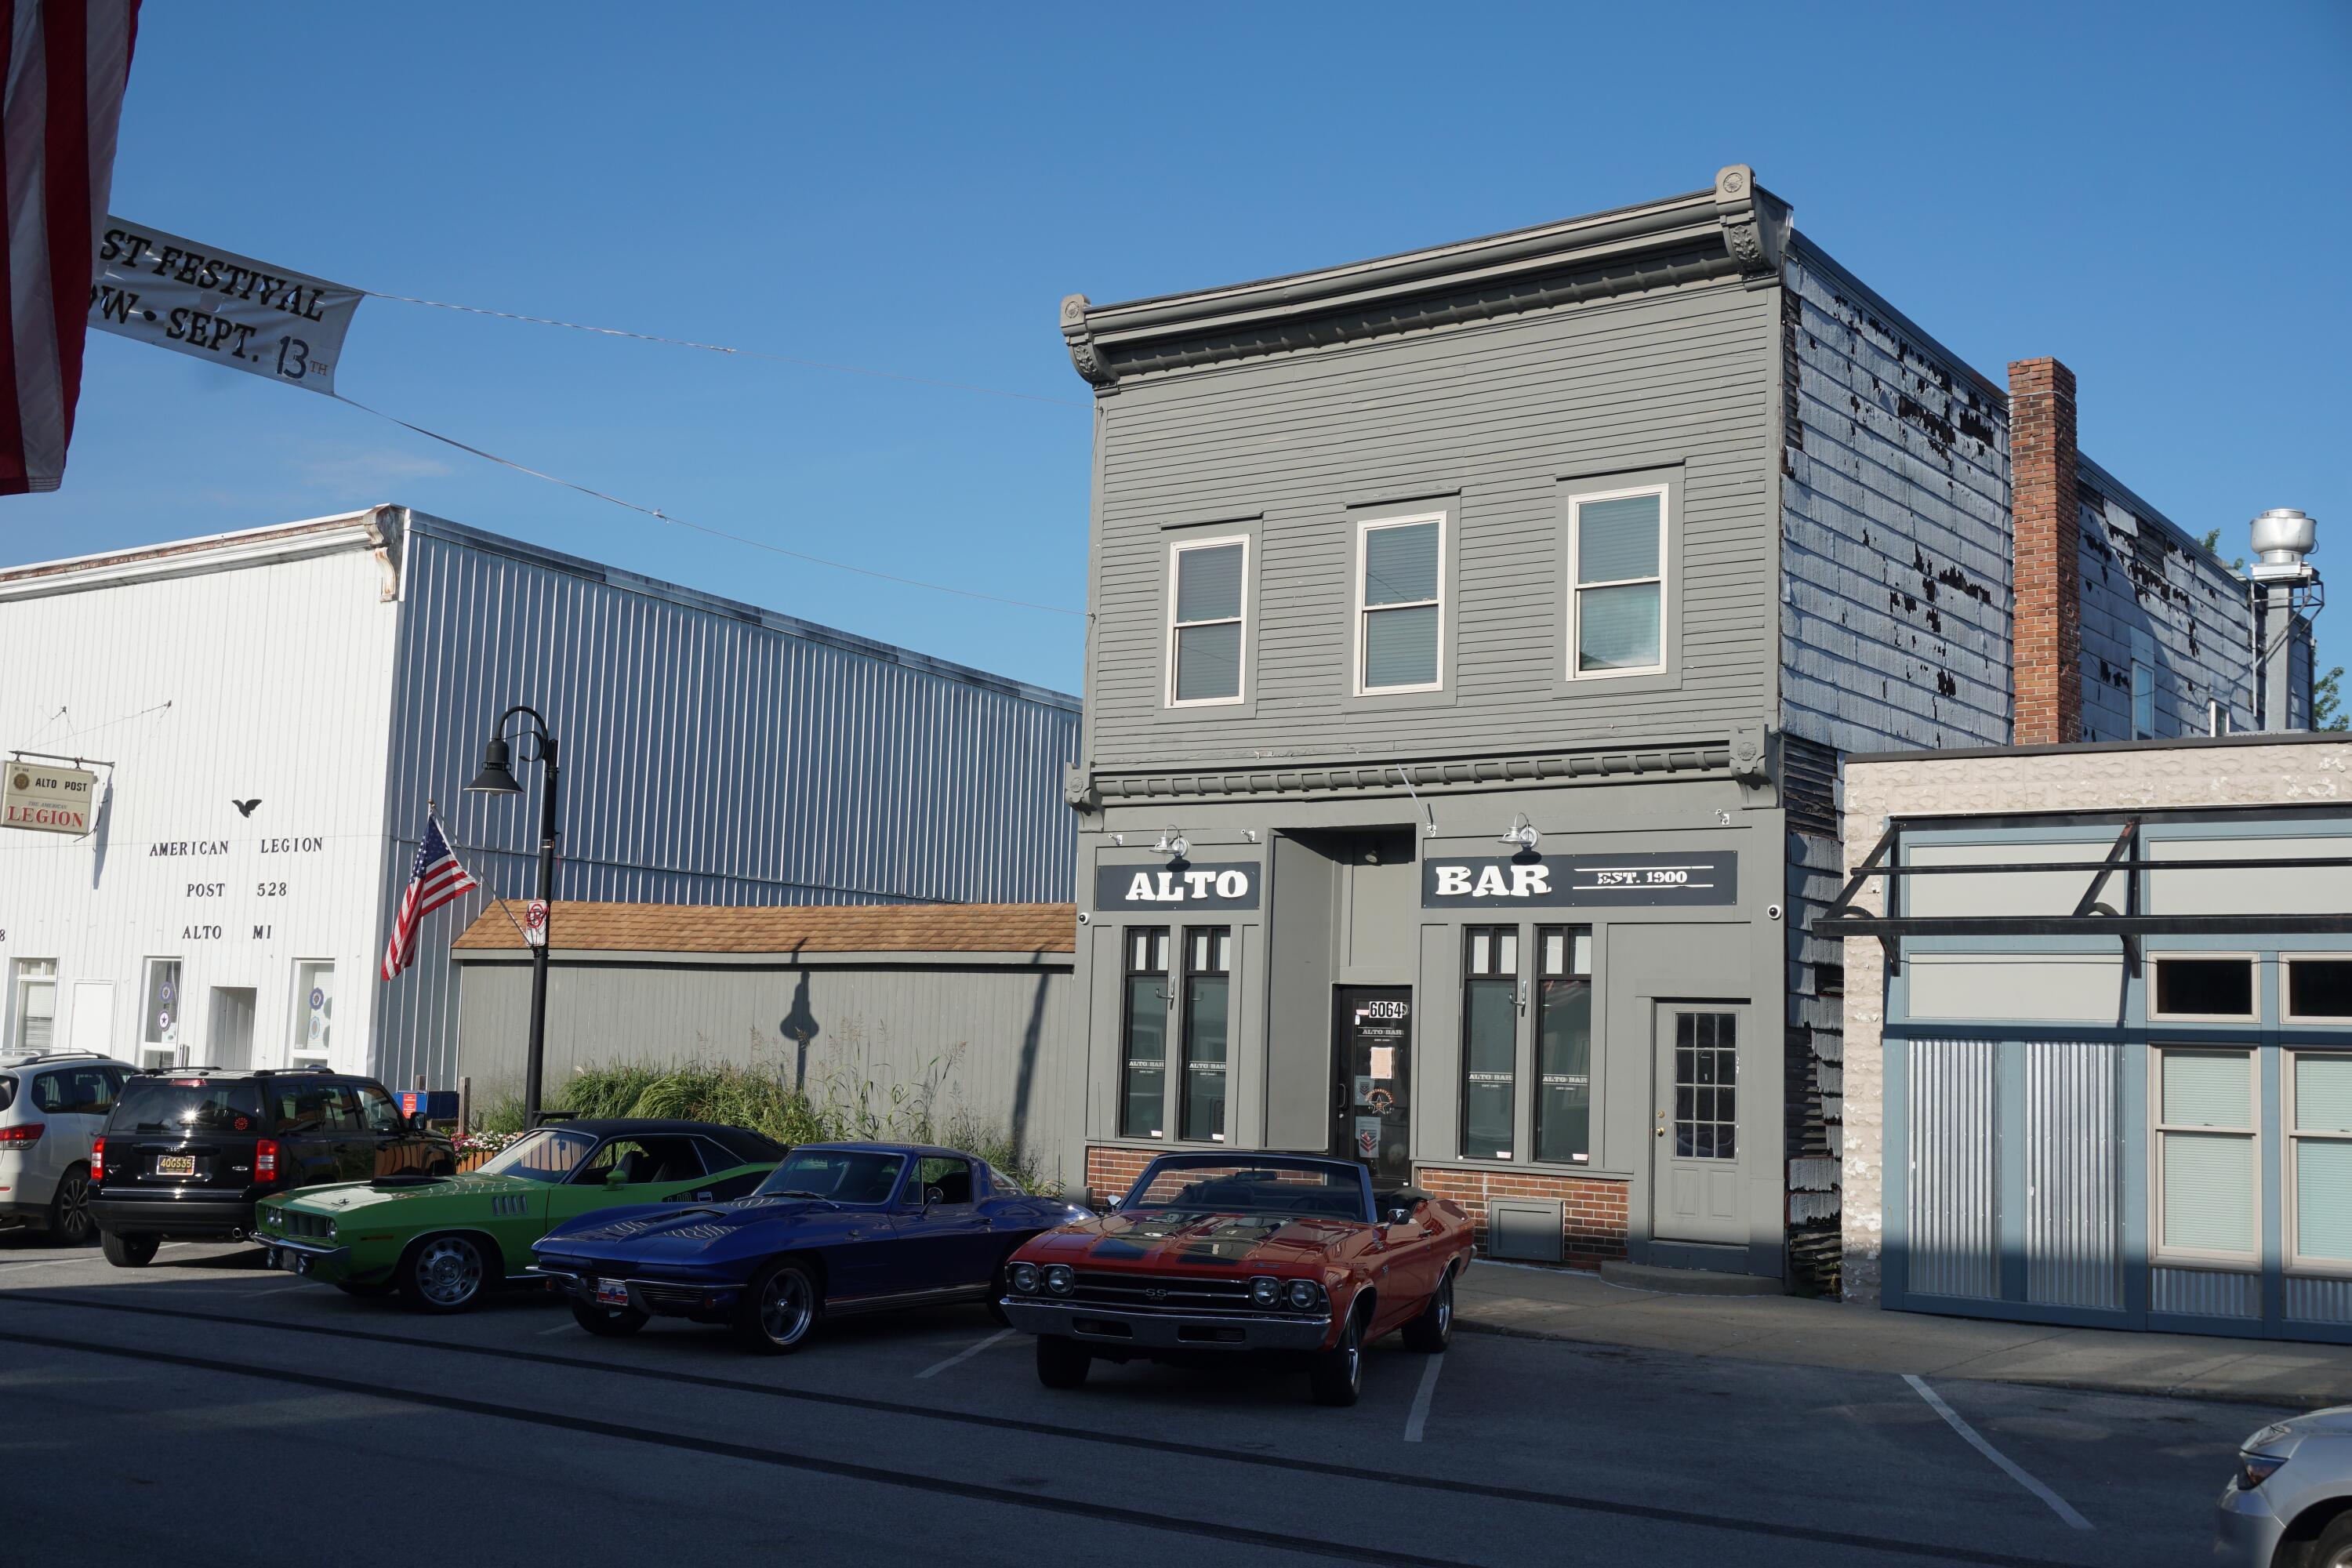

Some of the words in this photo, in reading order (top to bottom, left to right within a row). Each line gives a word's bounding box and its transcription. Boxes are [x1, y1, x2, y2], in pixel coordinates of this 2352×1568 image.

[151, 245, 325, 322] FESTIVAL
[166, 307, 259, 362] SEPT.
[35, 778, 57, 789] ALTO
[64, 781, 88, 792] POST
[7, 805, 85, 827] LEGION
[149, 840, 229, 857] AMERICAN
[260, 837, 323, 854] LEGION
[187, 883, 225, 897] POST
[256, 882, 287, 897] 528
[1125, 869, 1248, 902] ALTO
[1435, 865, 1552, 897] BAR
[1597, 871, 1641, 884] EST.
[1646, 870, 1687, 884] 1900
[182, 925, 222, 939] ALTO
[252, 925, 271, 939] MI
[1370, 1002, 1401, 1018] 6064
[1145, 1288, 1167, 1298] SS
